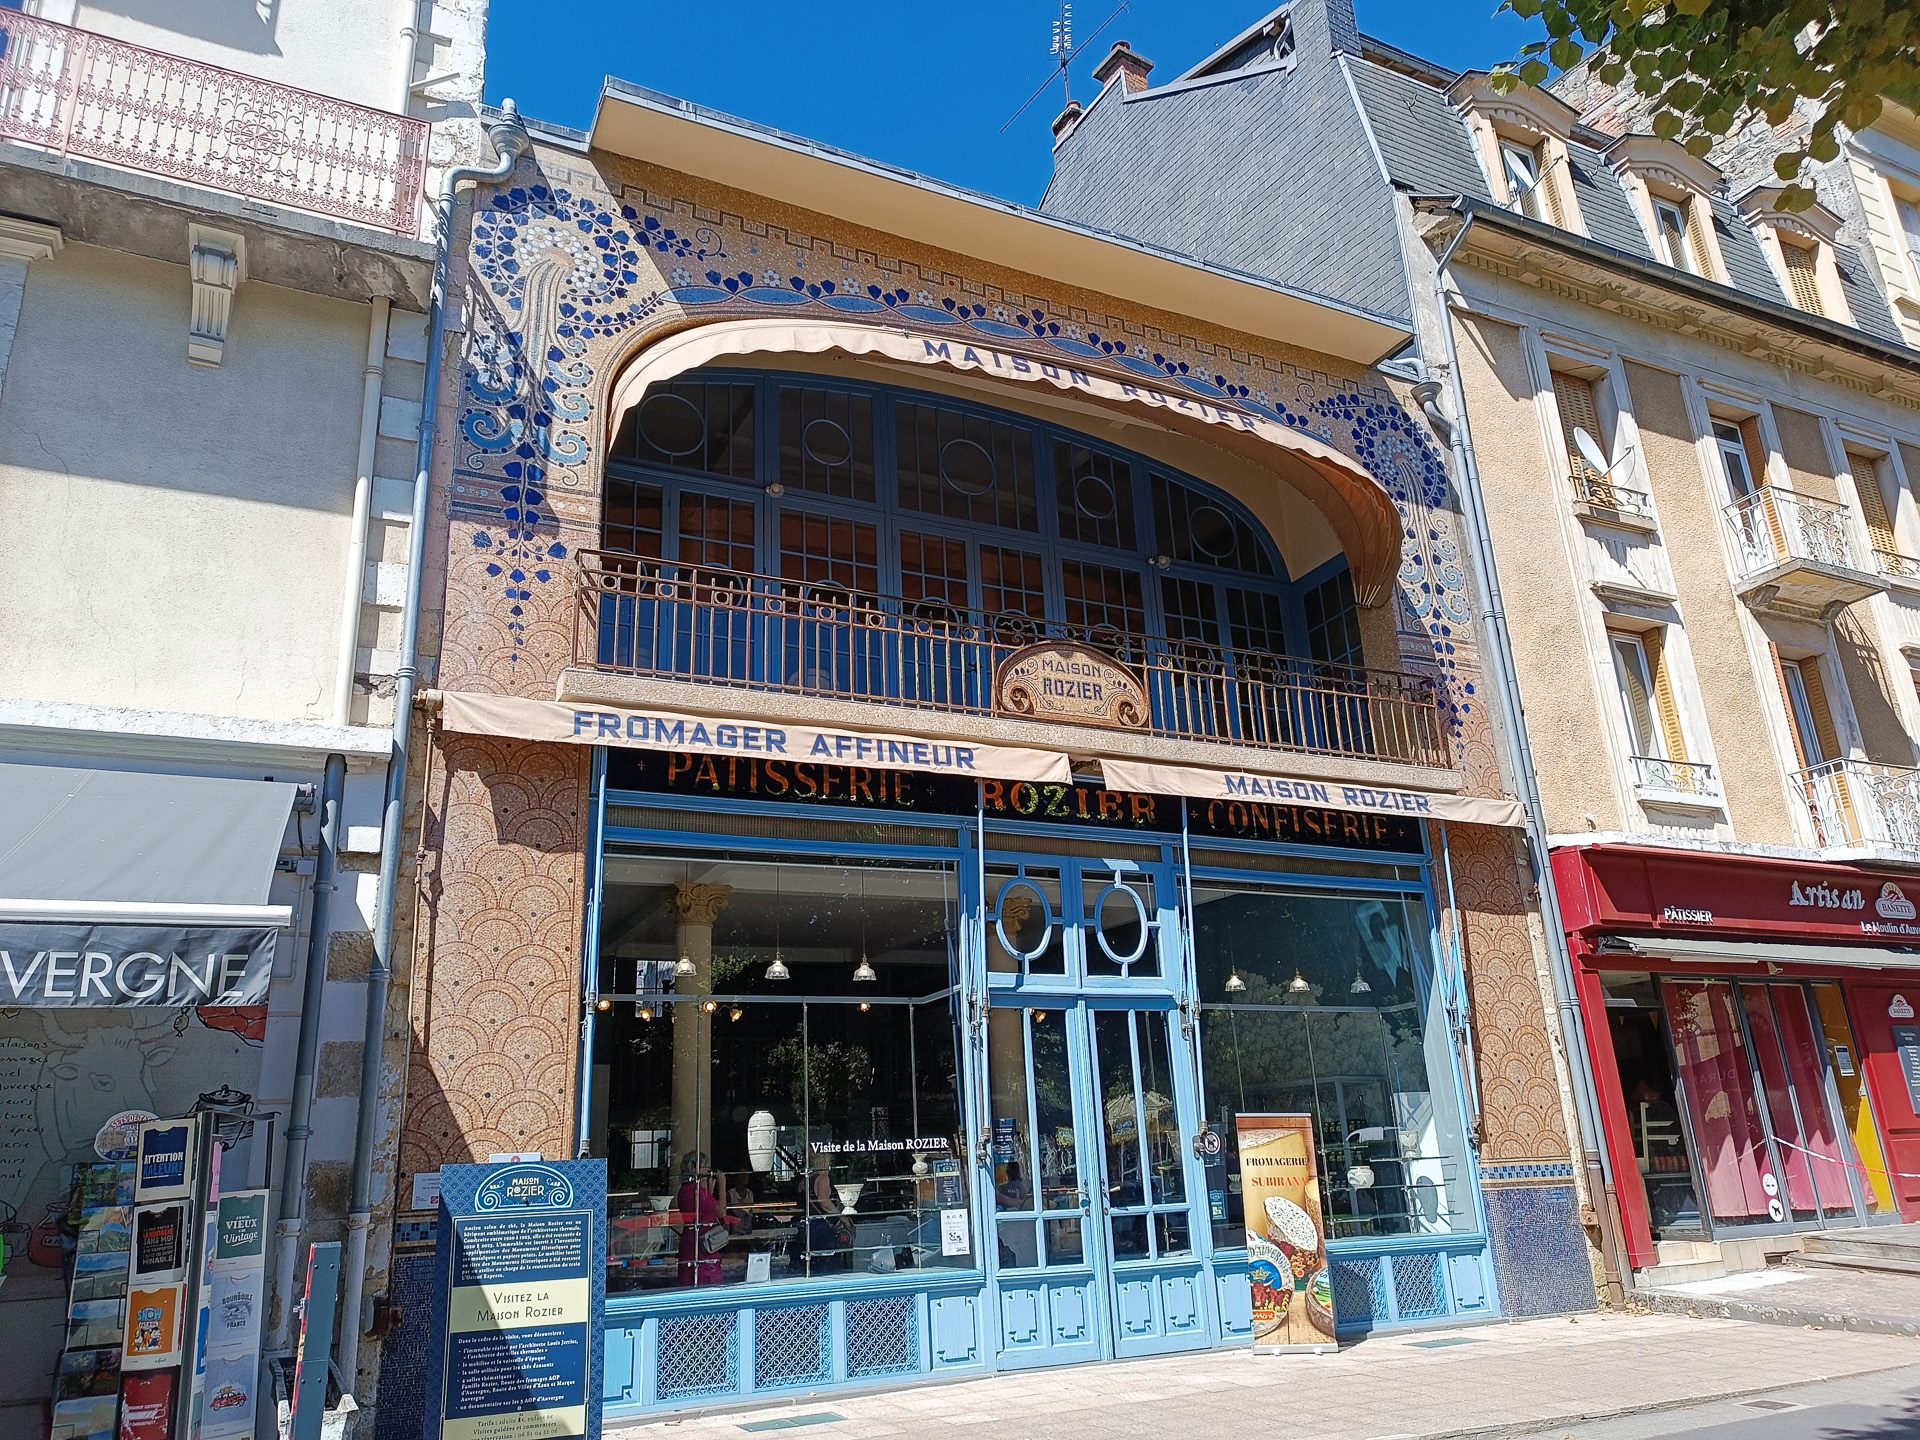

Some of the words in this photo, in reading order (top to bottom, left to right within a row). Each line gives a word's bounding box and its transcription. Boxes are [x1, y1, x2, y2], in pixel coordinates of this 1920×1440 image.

[923, 339, 1091, 387] MAISON
[1119, 381, 1258, 431] ROZIER
[1042, 659, 1101, 677] MAISON
[1043, 677, 1103, 700] ROZIER
[573, 711, 788, 754] FROMAGER
[810, 733, 976, 770] AFFINEUR
[667, 751, 915, 806] PATISSERIE
[974, 777, 1158, 825] ROZIER
[1208, 798, 1391, 847] CONFISERIE
[1224, 774, 1330, 803] MAISON
[1341, 786, 1432, 813] ROZIER
[1789, 880, 1866, 910] Artisan
[1663, 905, 1714, 923] PÂTISSIER
[1881, 903, 1912, 913] BANETTE
[1860, 920, 1872, 933] Le
[1872, 921, 1899, 935] Moulin
[1, 950, 249, 999] VERGNE
[810, 1141, 841, 1153] Visite
[843, 1141, 855, 1152] de
[856, 1140, 866, 1151] la
[867, 1139, 904, 1151] Maison
[905, 1137, 949, 1150] ROZIER
[144, 1151, 184, 1165] ATTENTION
[1246, 1157, 1308, 1166] FROMAGERIE
[511, 1177, 540, 1186] MAISON
[1251, 1176, 1308, 1187] SUBIRANA
[506, 1185, 545, 1197] ROZIER
[226, 1219, 258, 1230] VIEUX
[143, 1236, 159, 1246] SANS
[160, 1235, 174, 1243] MOI
[223, 1230, 259, 1244] Vintage
[142, 1254, 174, 1265] MINABLE
[226, 1320, 246, 1329] FRANCE
